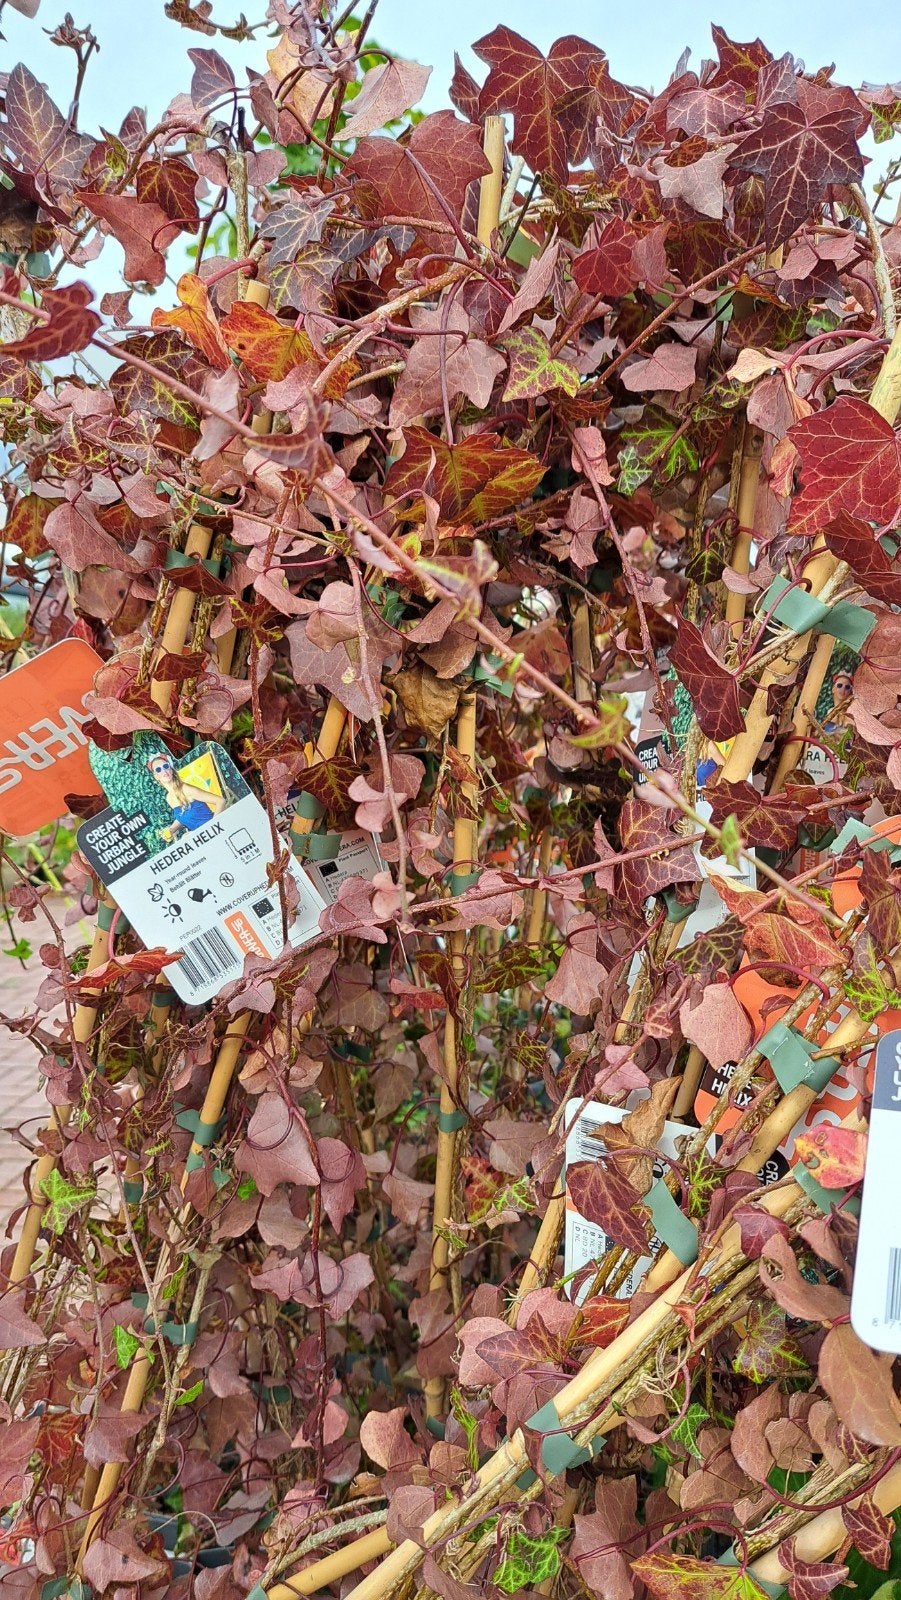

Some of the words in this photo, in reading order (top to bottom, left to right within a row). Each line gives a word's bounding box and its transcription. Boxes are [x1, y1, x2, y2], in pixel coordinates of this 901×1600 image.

[85, 813, 125, 844] CREATE
[90, 830, 122, 854] YOUR
[121, 813, 147, 836] OWN
[98, 836, 135, 864] URBAN
[107, 843, 146, 875] JUNGLE
[149, 843, 194, 875] HEDERA
[192, 821, 225, 848] HELIX
[164, 864, 191, 884] Year-round
[191, 856, 207, 869] leaves
